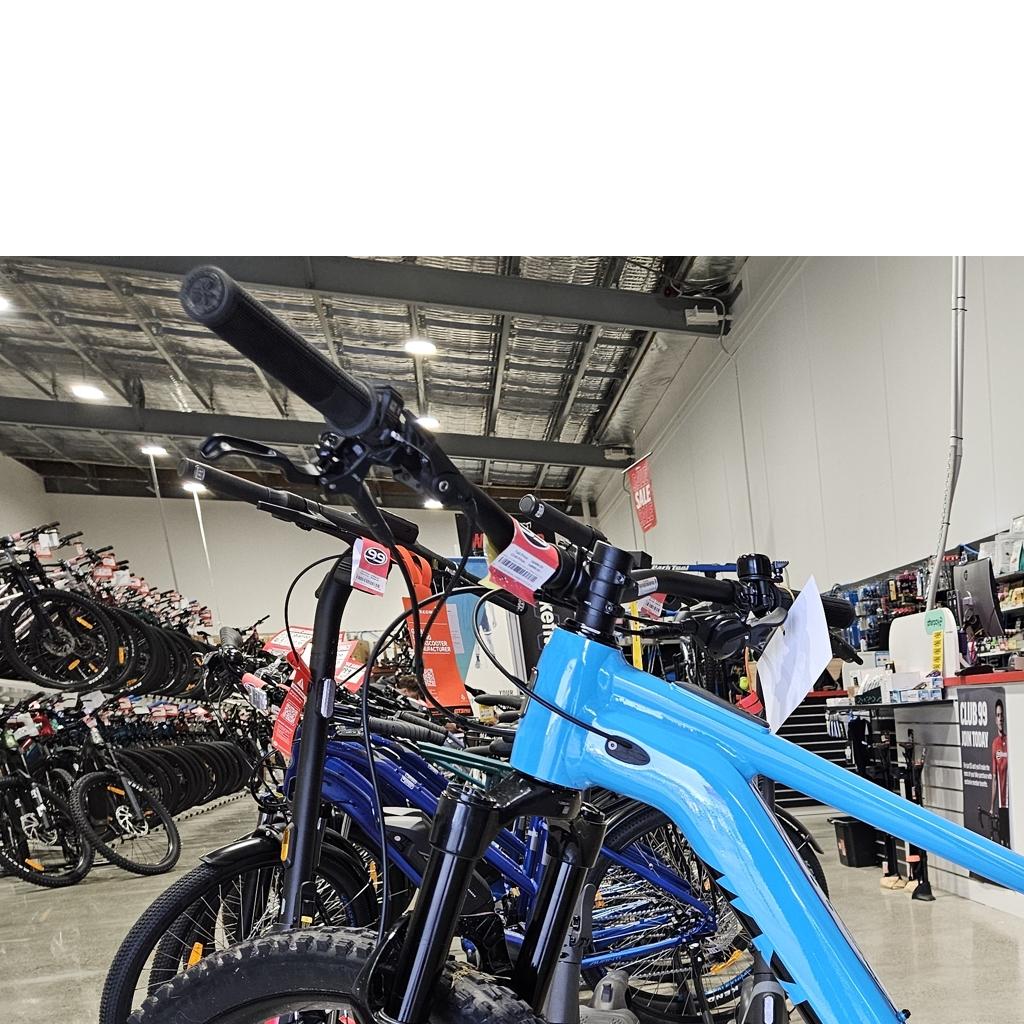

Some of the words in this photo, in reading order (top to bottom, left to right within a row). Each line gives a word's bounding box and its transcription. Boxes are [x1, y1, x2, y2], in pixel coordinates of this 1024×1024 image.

[635, 485, 652, 510] SALE
[365, 548, 388, 565] 99
[960, 701, 978, 726] CLUB
[977, 700, 988, 726] 99
[961, 730, 972, 747] JOIN
[972, 731, 989, 748] TODAY
[708, 985, 740, 1003] KEND
